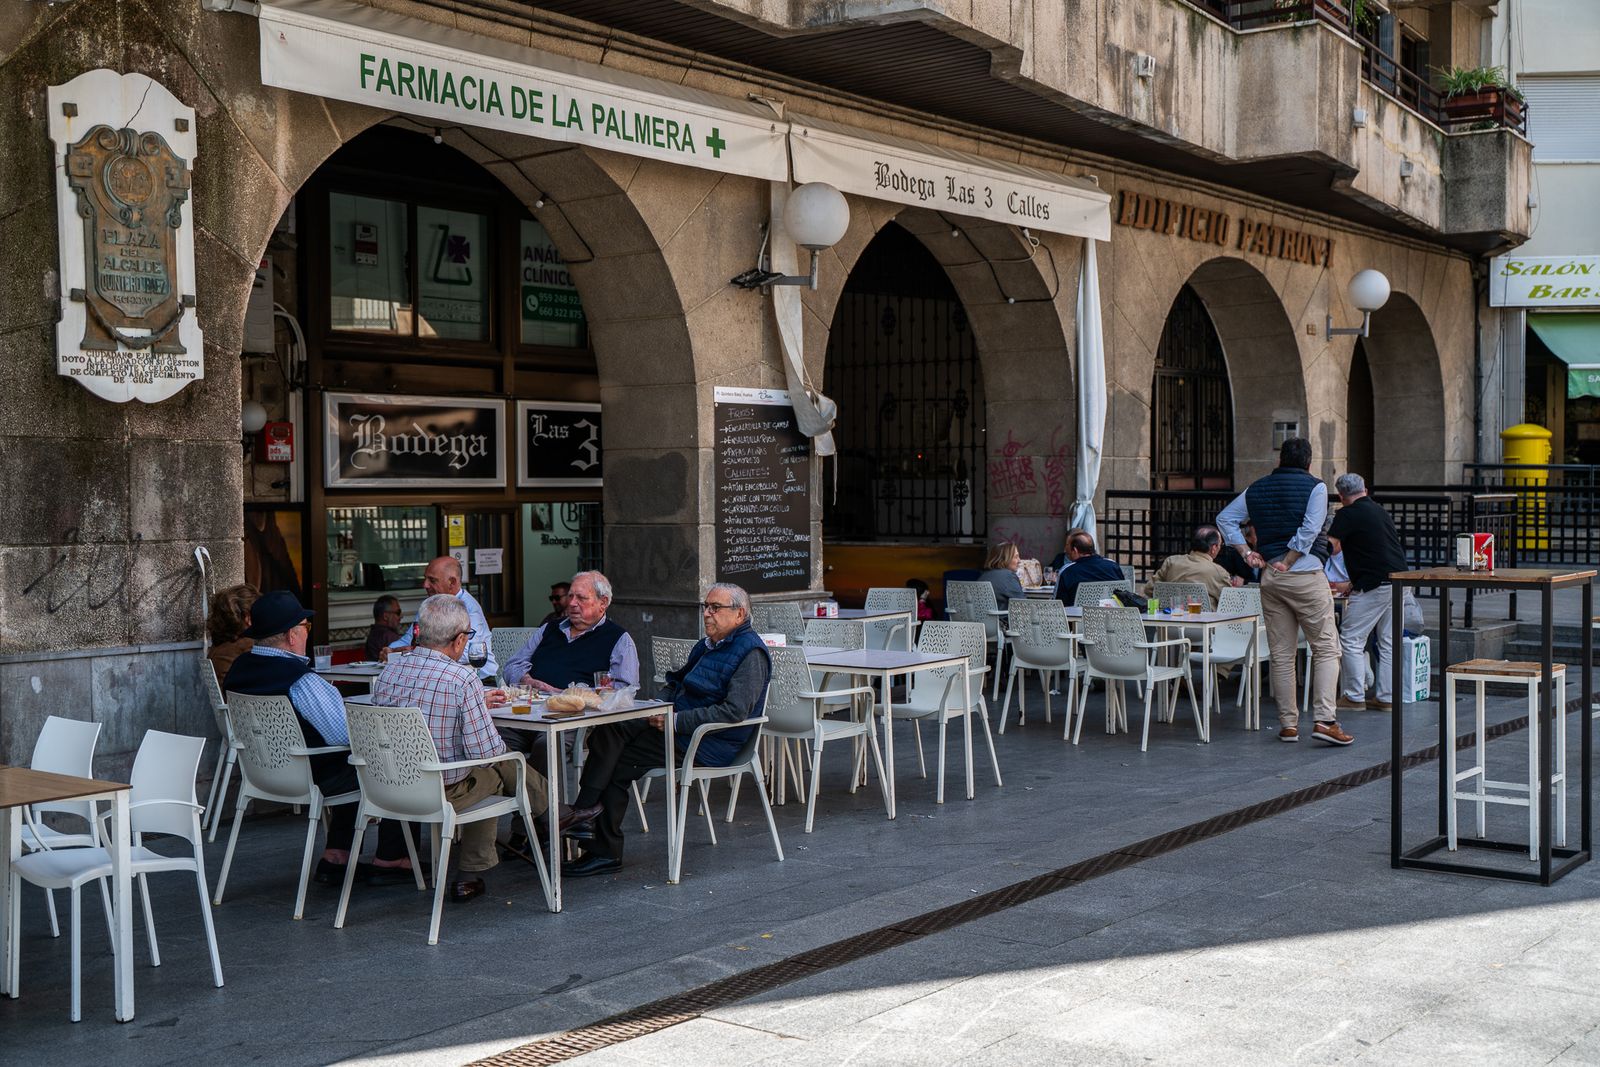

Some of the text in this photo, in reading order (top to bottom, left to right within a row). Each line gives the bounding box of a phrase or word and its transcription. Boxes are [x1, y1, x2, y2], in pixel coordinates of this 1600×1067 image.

[360, 53, 696, 154] FARMACIA DE LA PALMERA
[874, 160, 1050, 221] Bodega Las 3 Calles
[103, 229, 160, 249] PLAZA
[120, 248, 143, 257] DEL
[103, 257, 162, 274] ALCALDE
[1501, 261, 1596, 276] SALÓN
[1528, 285, 1591, 299] BAR
[62, 356, 86, 364] DOTO
[86, 350, 177, 360] CIUDADANO EJEMPLAR
[83, 369, 127, 377] COMPLETO
[128, 370, 196, 379] ABASTECIMIENTO
[86, 363, 139, 372] INTELIGENTE
[148, 365, 179, 373] CELOSA
[350, 414, 488, 470] Bodega
[531, 414, 600, 471] Las 3
